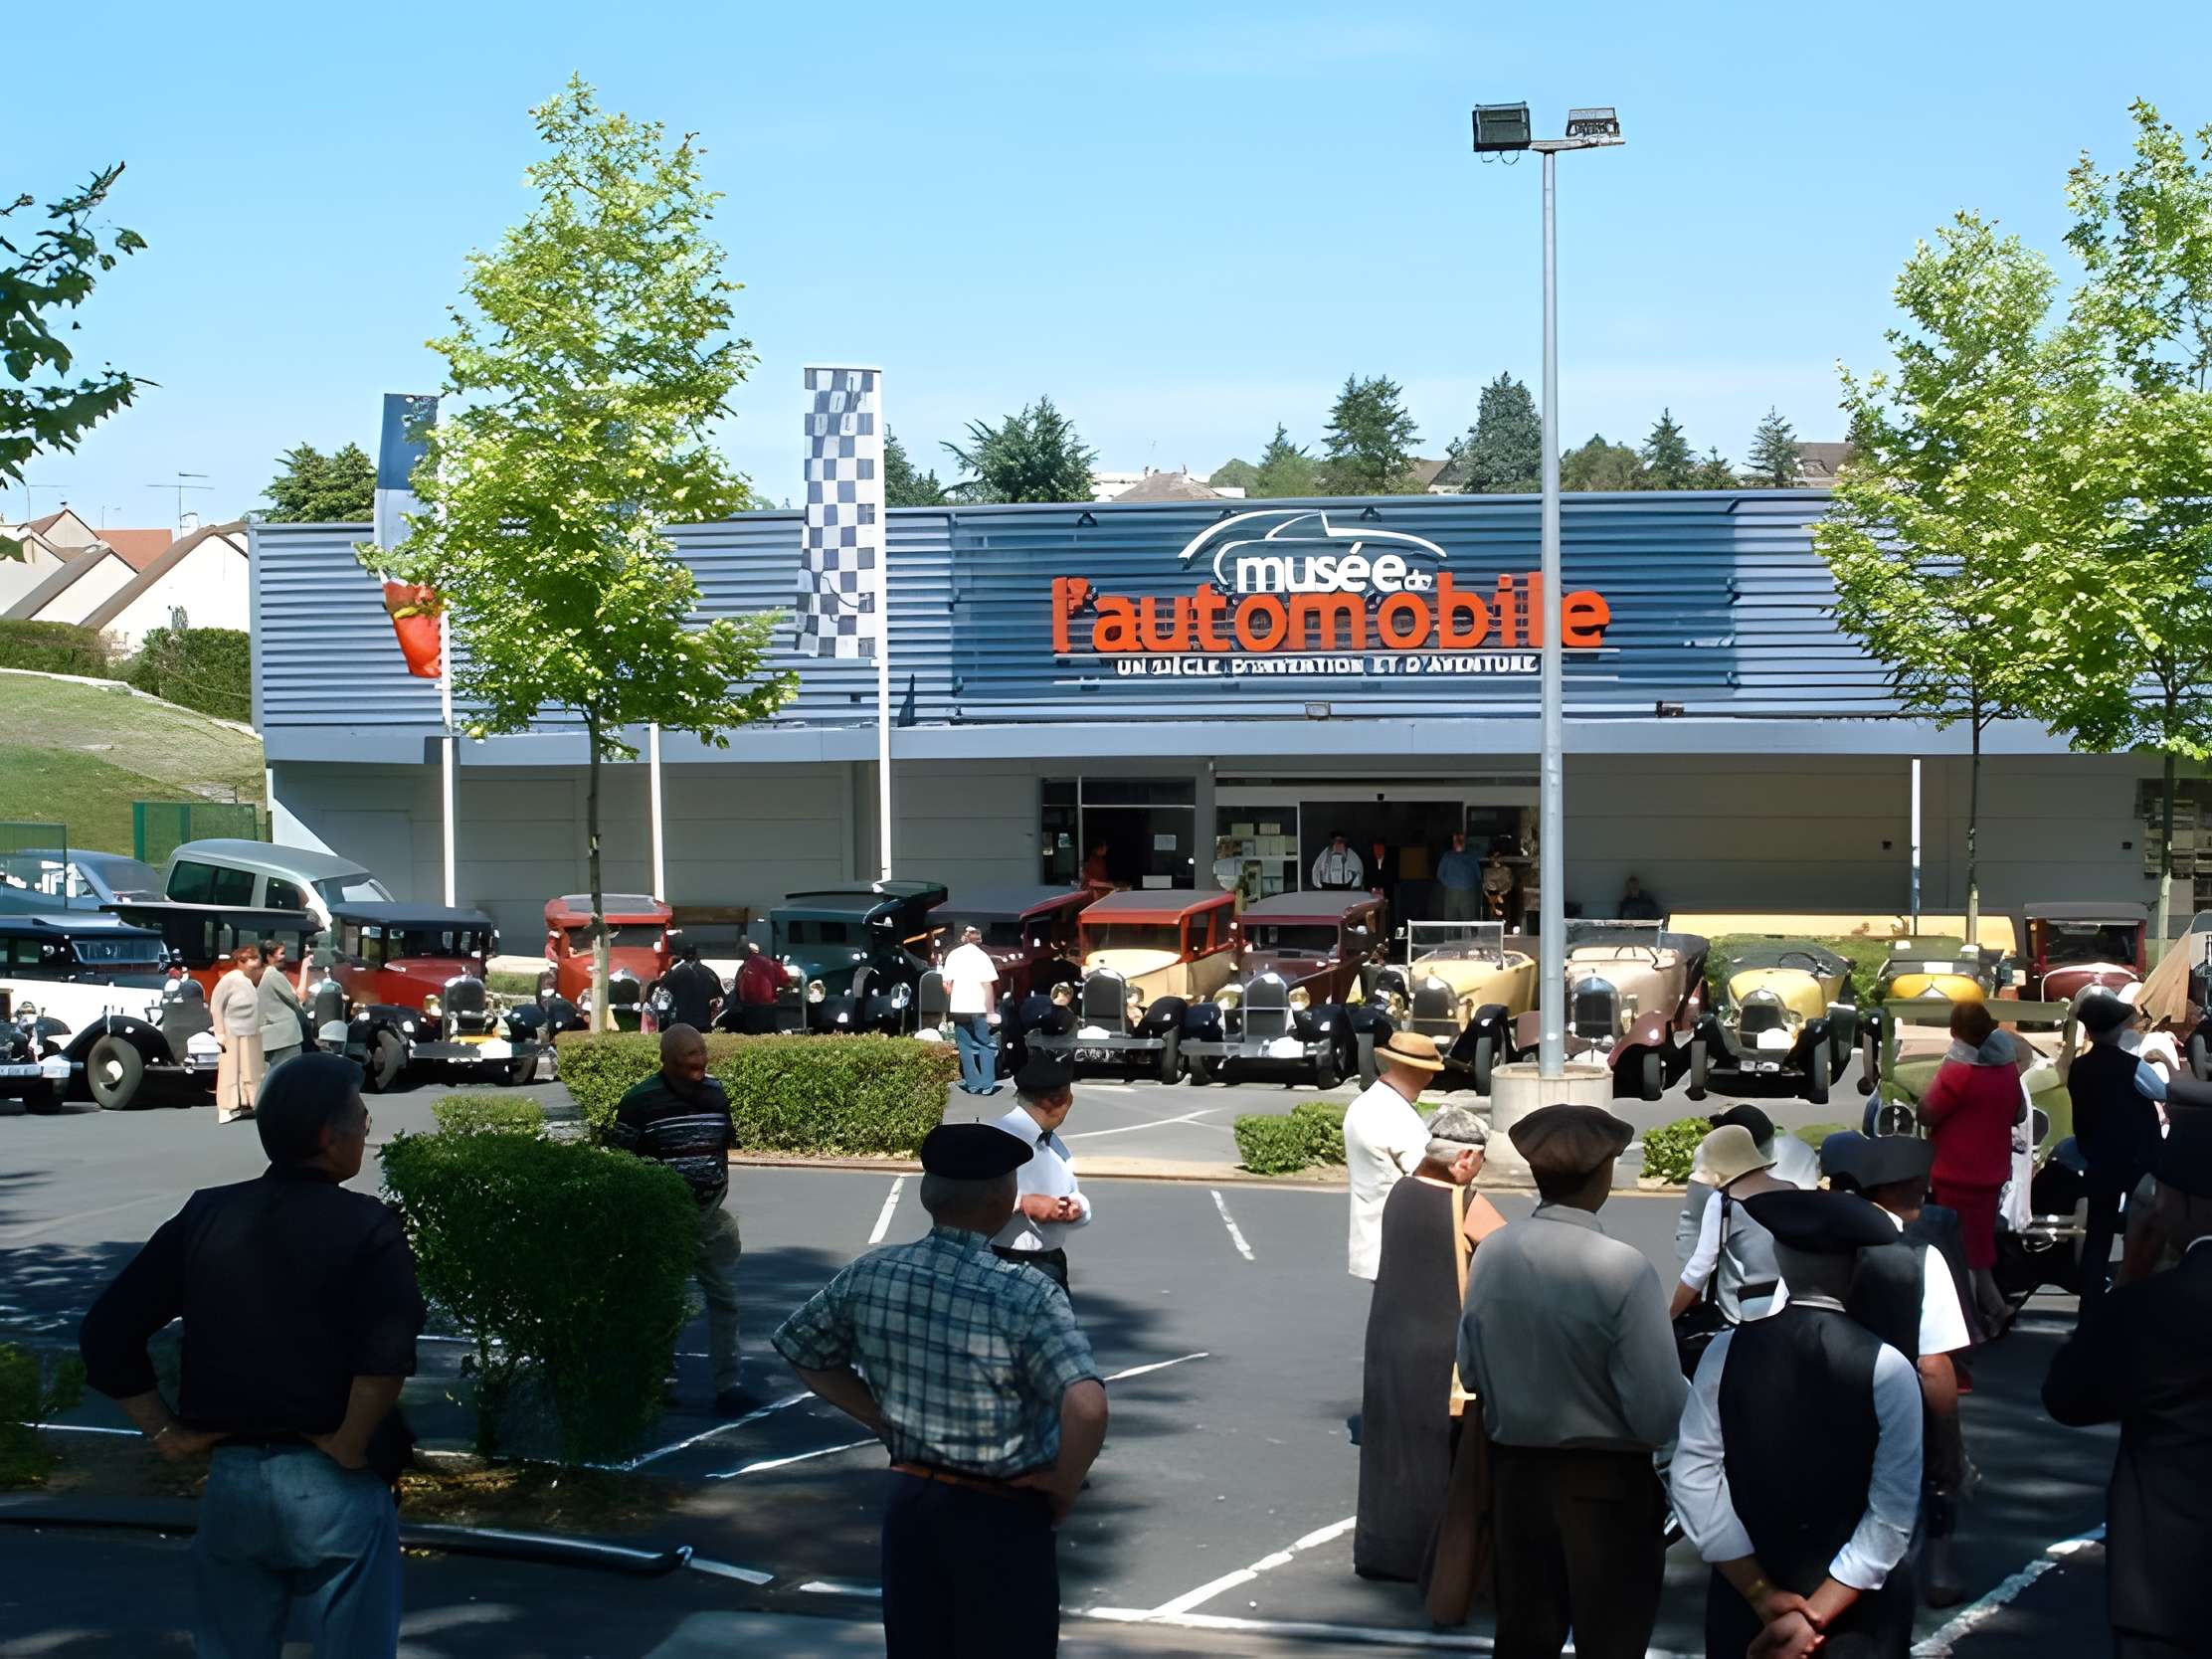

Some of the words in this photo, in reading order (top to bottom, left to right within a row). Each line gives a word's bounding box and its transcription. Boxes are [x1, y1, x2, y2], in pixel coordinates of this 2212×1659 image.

[1236, 541, 1407, 594] musée
[1051, 571, 1611, 653] l'automobile
[1117, 657, 1147, 675] UN
